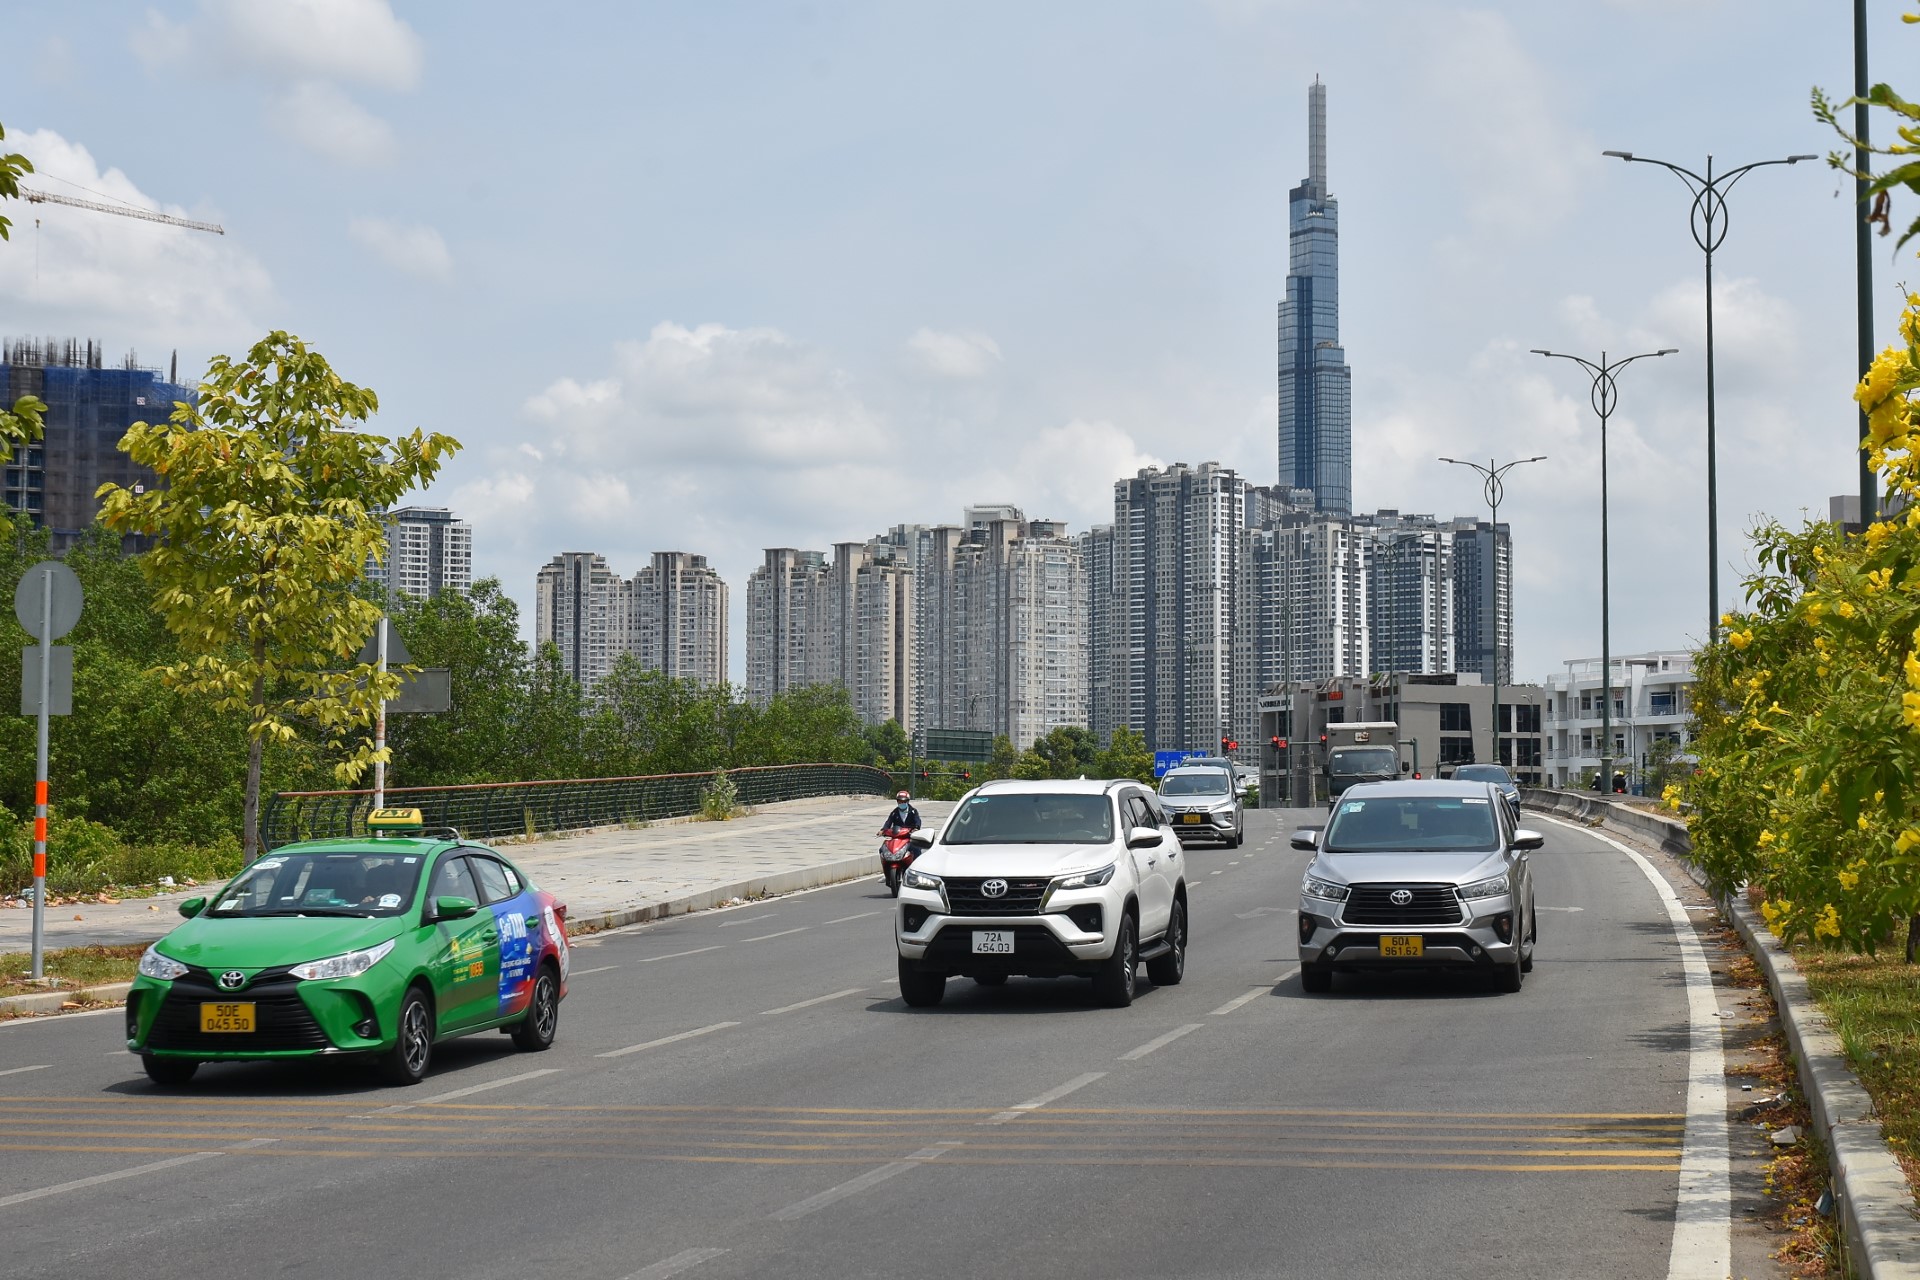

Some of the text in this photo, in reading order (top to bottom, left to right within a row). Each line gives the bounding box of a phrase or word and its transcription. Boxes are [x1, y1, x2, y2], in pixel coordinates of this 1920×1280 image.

[984, 932, 1002, 942] 72A
[1391, 937, 1410, 946] 60A
[976, 943, 1010, 952] 454.03
[1384, 946, 1418, 956] 961.62
[216, 1005, 239, 1017] 50E
[207, 1018, 249, 1031] 045.50
